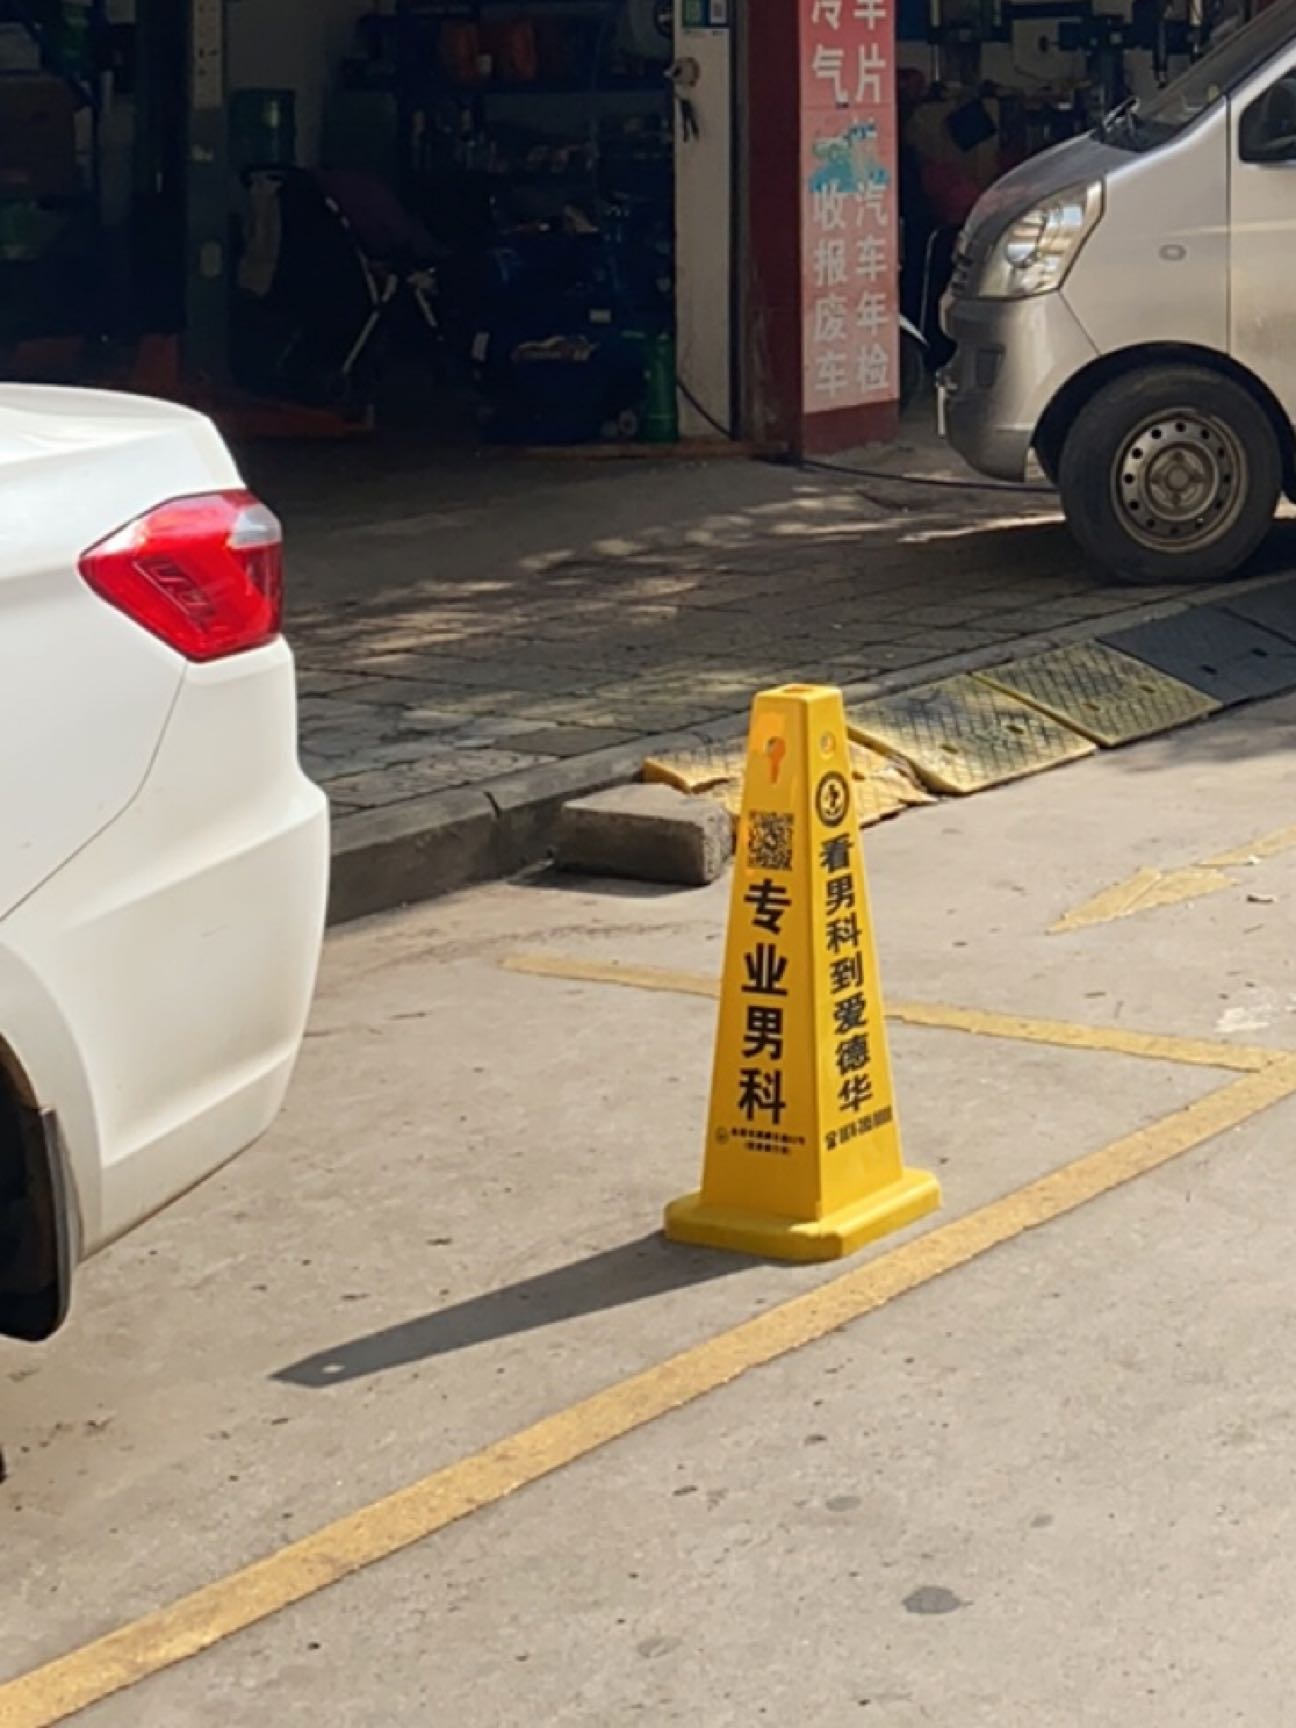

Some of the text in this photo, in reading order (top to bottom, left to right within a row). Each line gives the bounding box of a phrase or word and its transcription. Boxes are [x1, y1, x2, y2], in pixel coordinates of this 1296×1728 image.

[811, 182, 848, 398] 收报废车
[854, 181, 889, 394] 汽车年检
[738, 878, 792, 1124] 专业男科
[819, 832, 873, 1113] 看男科到爱德华
